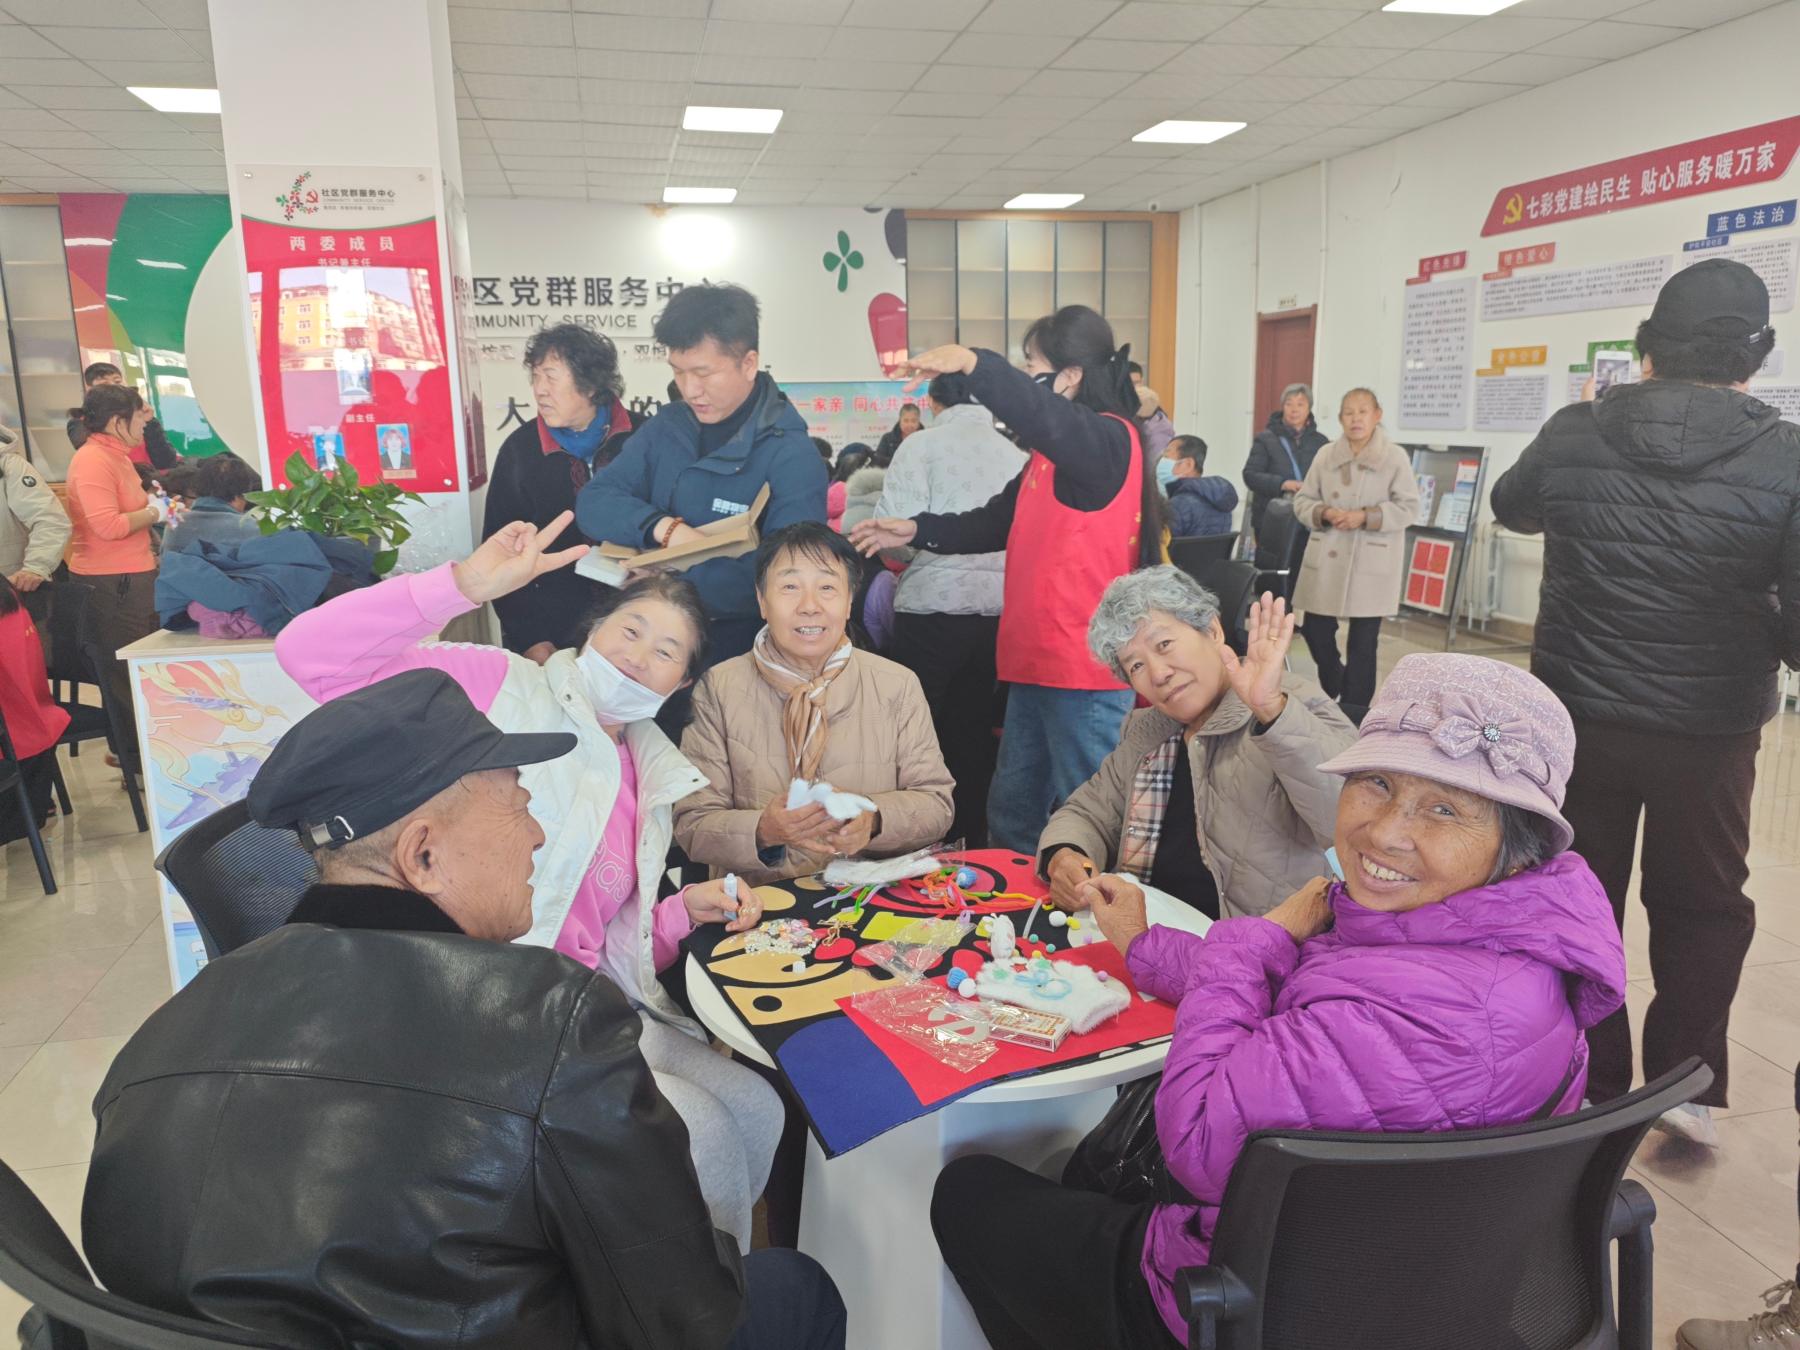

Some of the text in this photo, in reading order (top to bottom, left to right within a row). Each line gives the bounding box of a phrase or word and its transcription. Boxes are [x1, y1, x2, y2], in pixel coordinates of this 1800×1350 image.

[1526, 141, 1777, 219] 七彩党建绘民生 贴心服务暖万家
[1716, 206, 1784, 232] 蓝色法治
[289, 236, 395, 251] 两委成员
[472, 276, 711, 307] 区党群服务中
[475, 314, 548, 328] MUNITY
[562, 314, 637, 328] SERVICE
[791, 396, 843, 413] 一家亲
